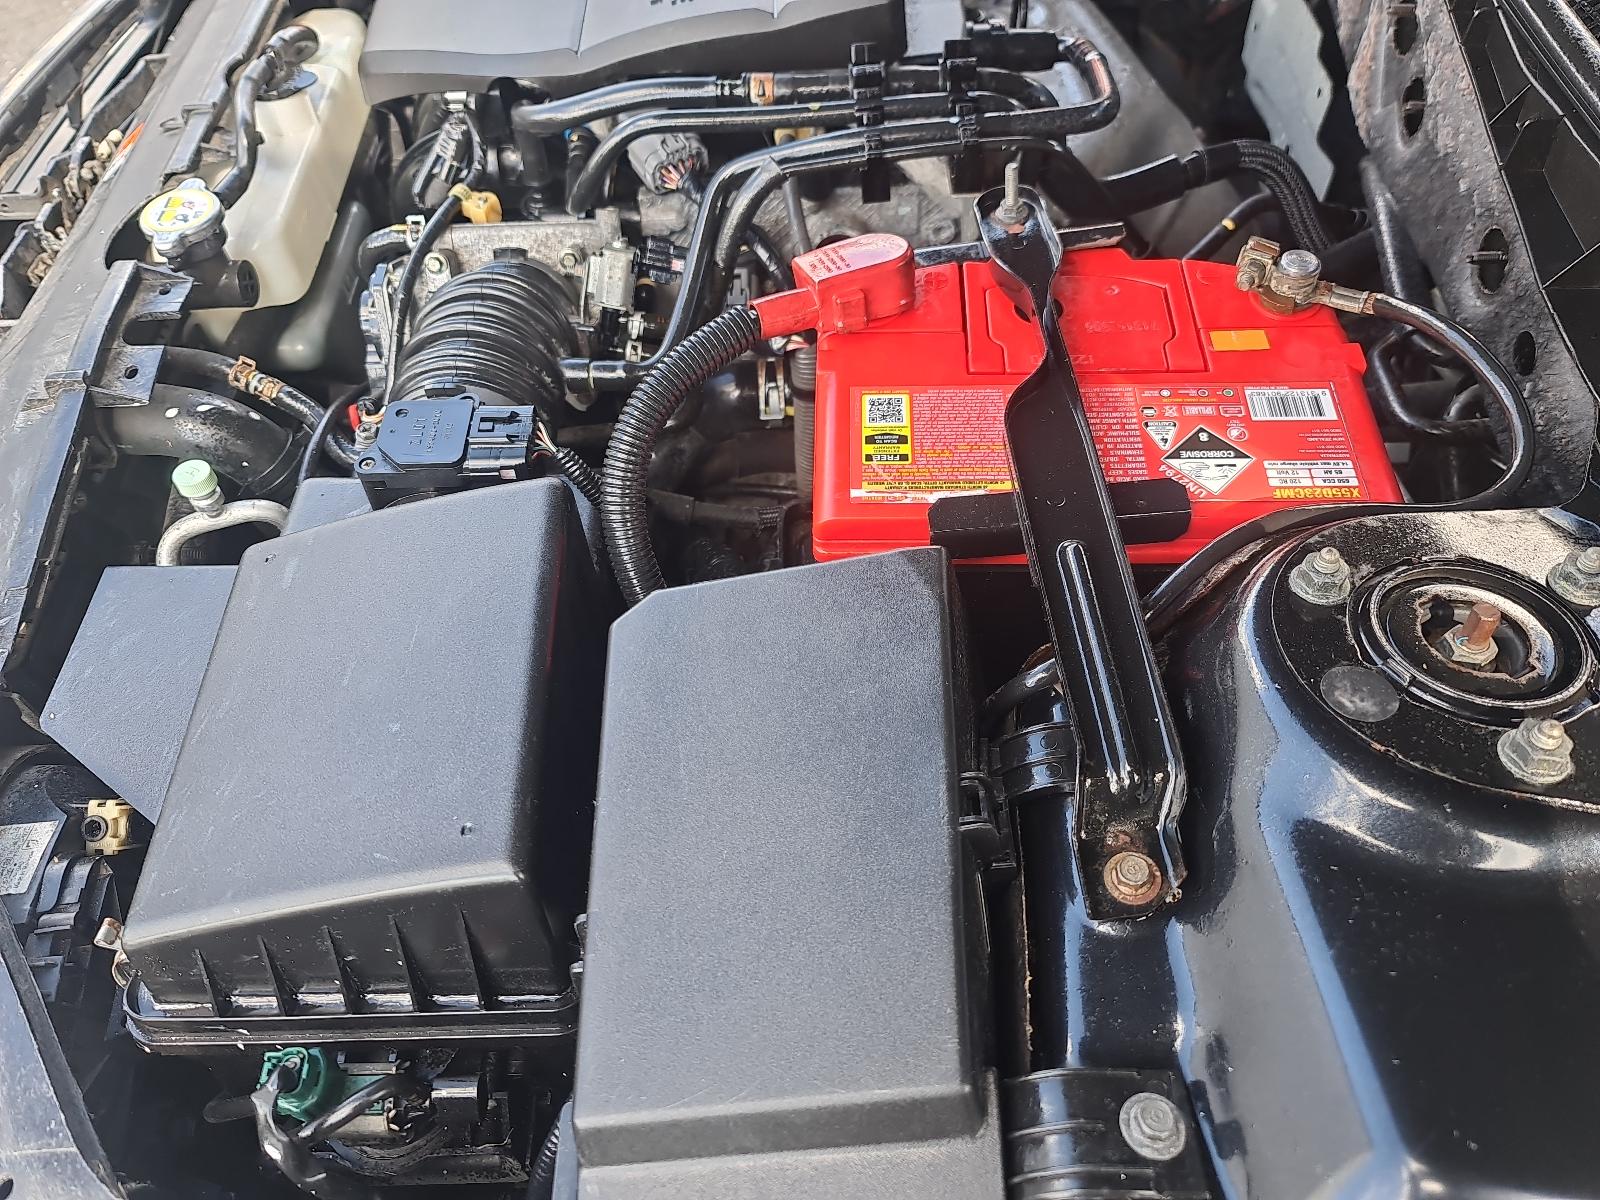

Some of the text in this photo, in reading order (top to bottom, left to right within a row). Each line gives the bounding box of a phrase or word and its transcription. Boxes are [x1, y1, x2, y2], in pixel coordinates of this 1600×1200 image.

[1198, 432, 1210, 442] 8
[1179, 450, 1235, 458] CORROSIVE
[1158, 464, 1206, 498] UN2794
[1272, 488, 1361, 499] X55D23CMF
